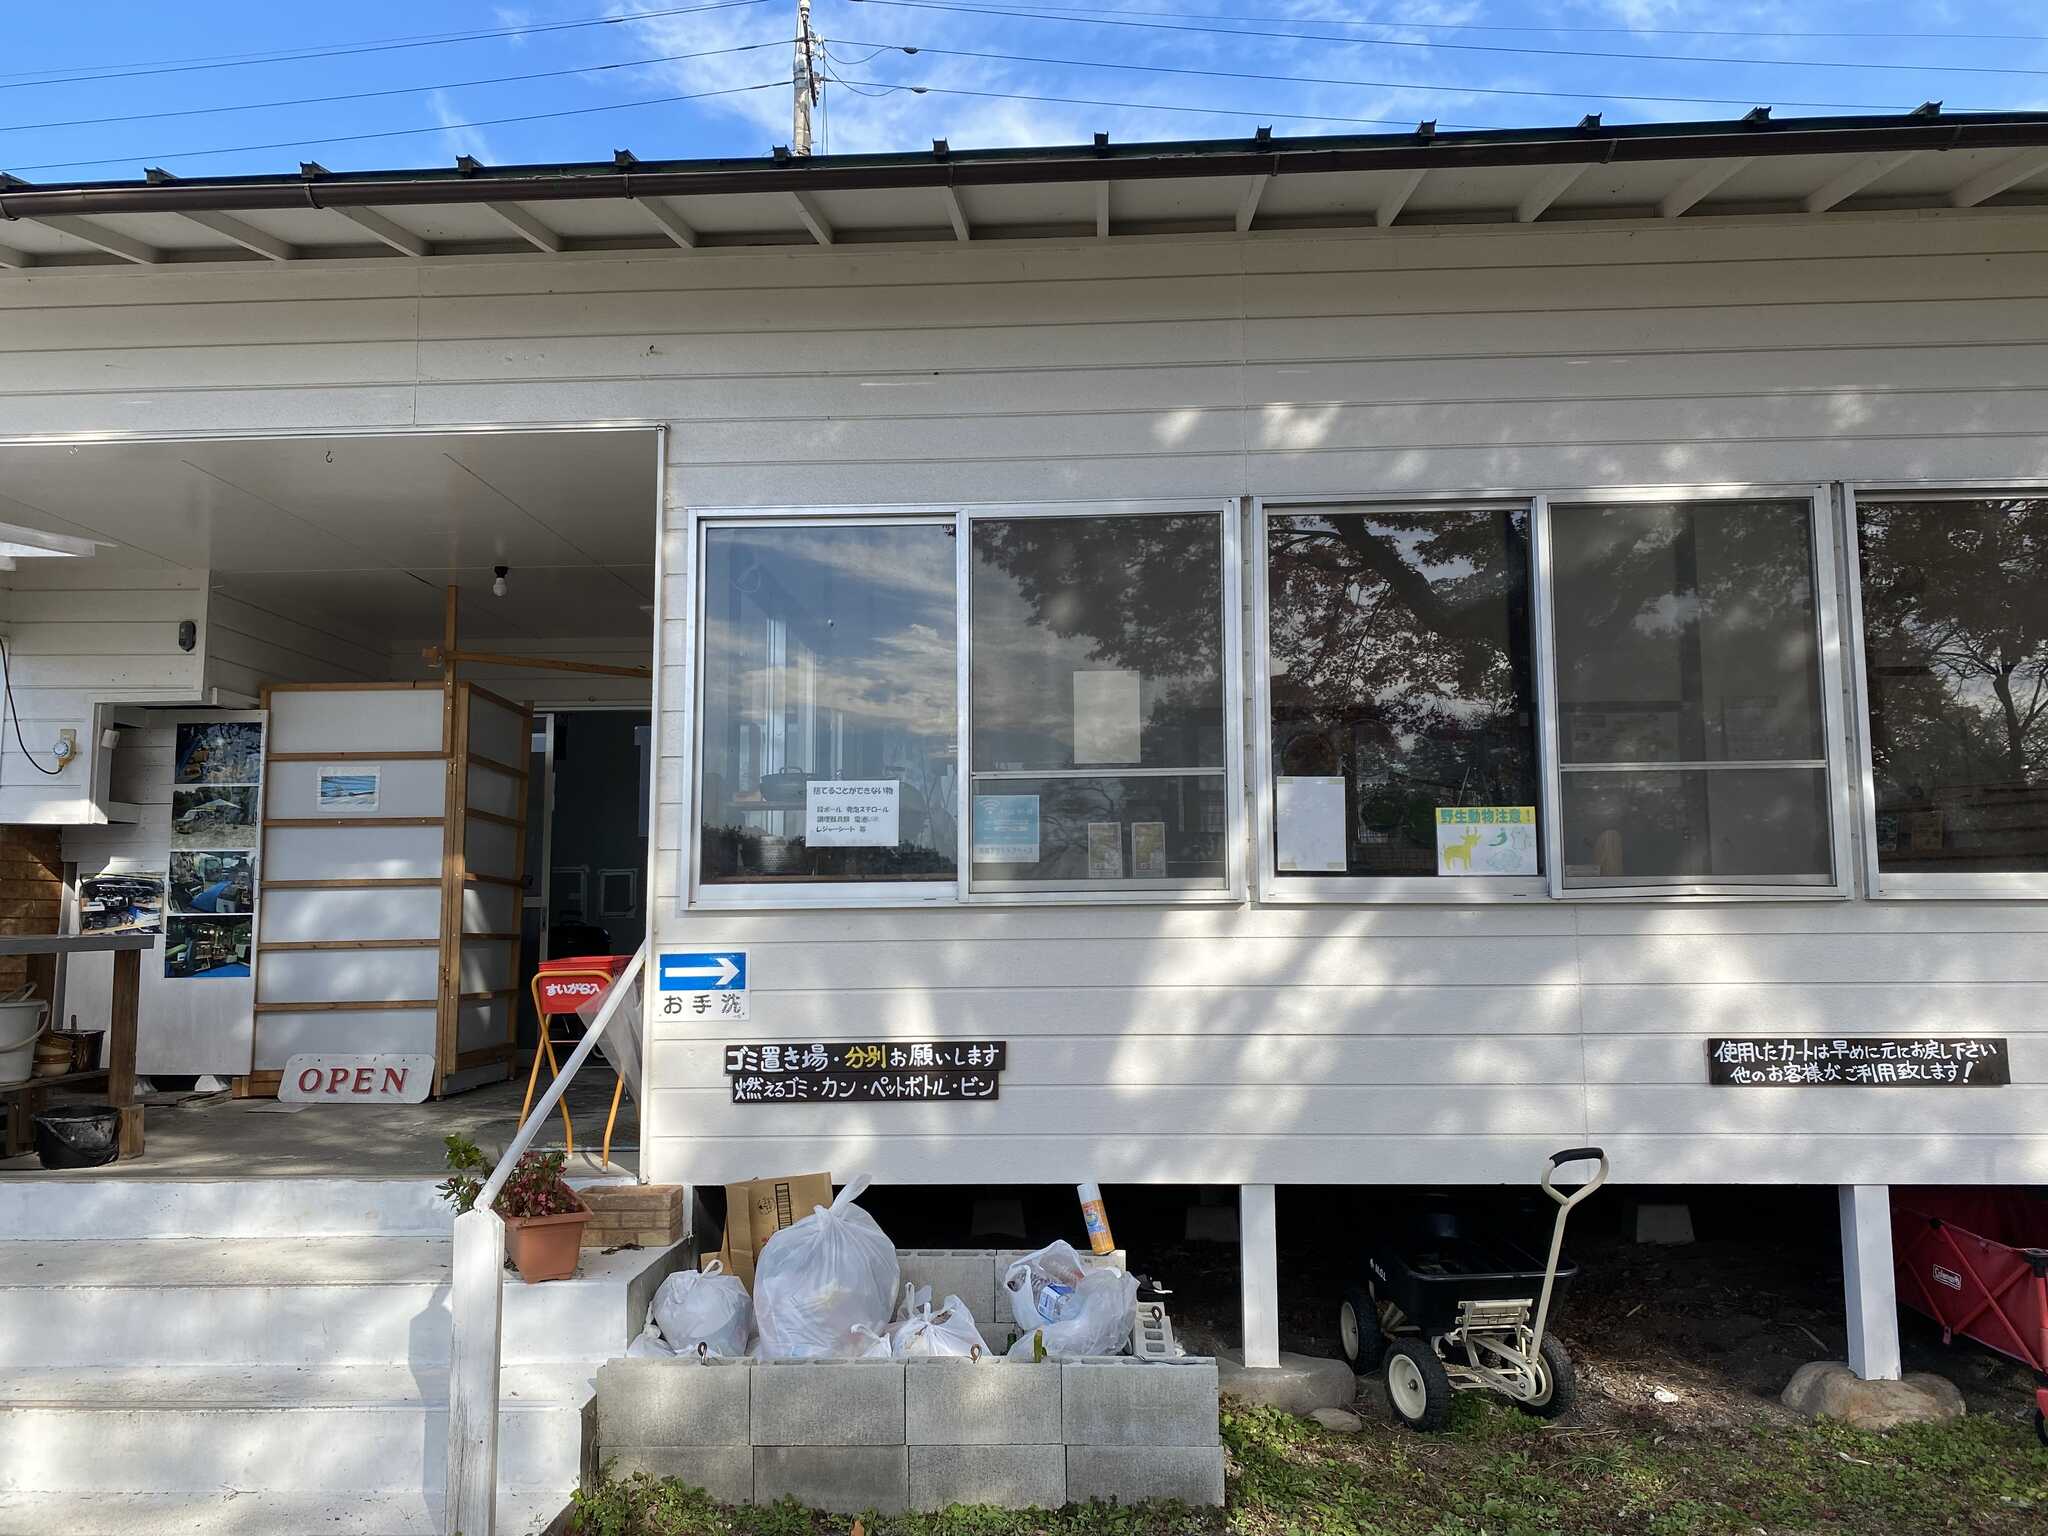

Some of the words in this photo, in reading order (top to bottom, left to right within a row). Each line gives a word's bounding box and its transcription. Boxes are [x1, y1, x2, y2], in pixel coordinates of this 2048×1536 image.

[726, 1044, 1000, 1073] ゴミ置き場・分別お願いします
[1713, 1039, 1999, 1063] 使用したカートは早めに元にお戻し下さい
[298, 1067, 409, 1094] OPEN
